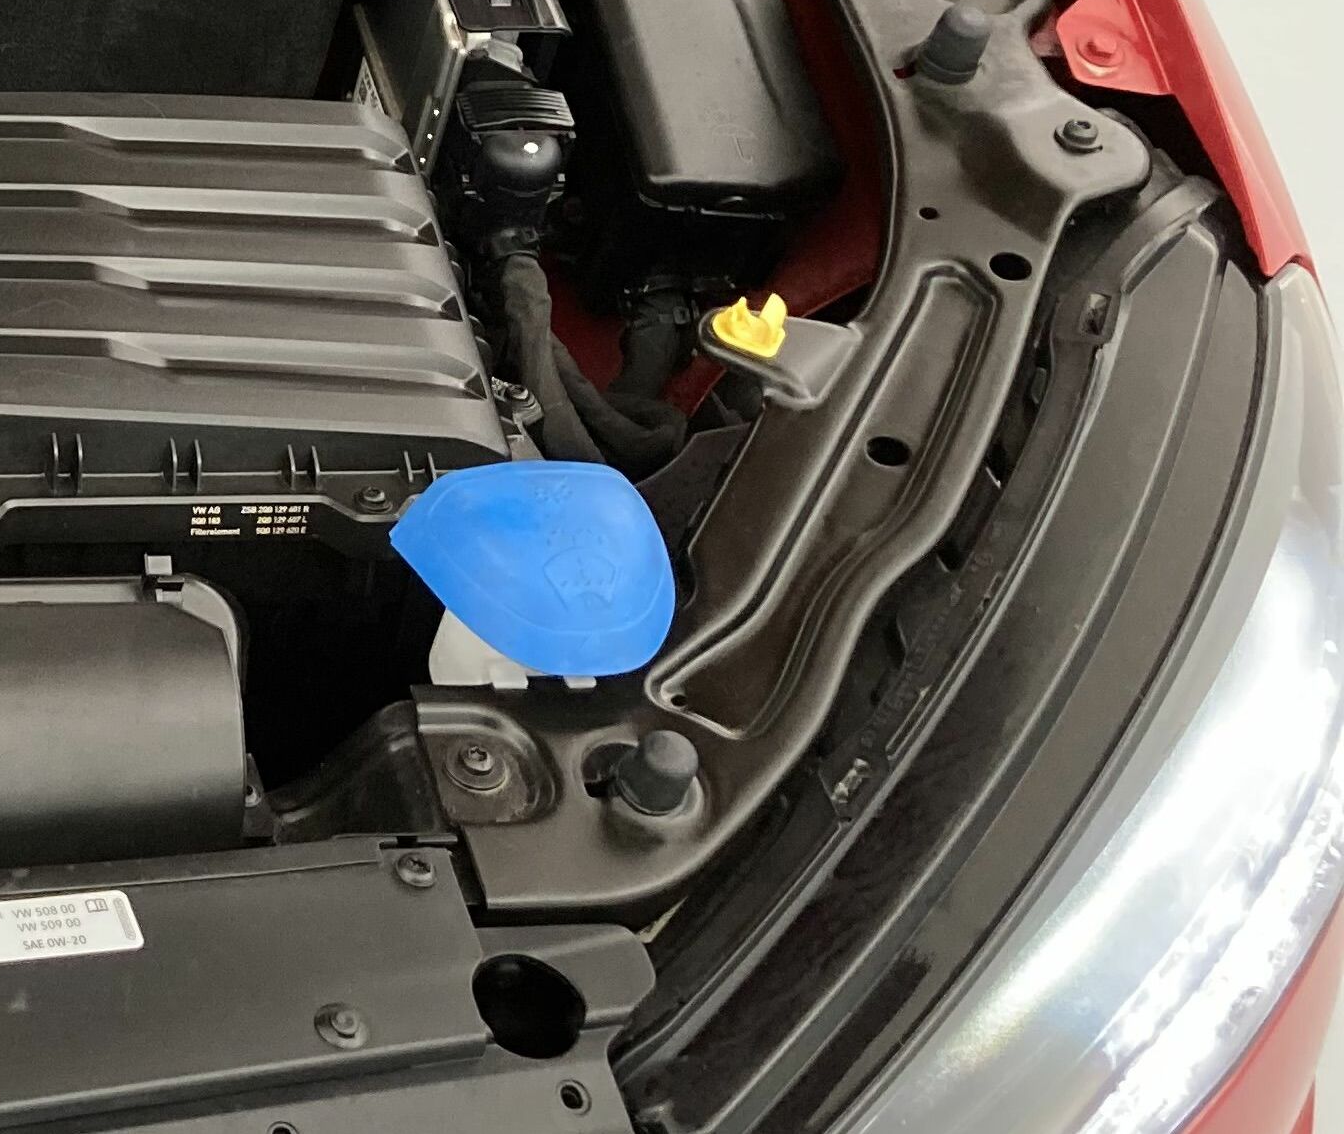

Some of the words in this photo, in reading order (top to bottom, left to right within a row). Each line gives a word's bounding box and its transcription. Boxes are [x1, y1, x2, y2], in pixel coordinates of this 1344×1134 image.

[192, 506, 207, 515] VW
[207, 506, 221, 515] AG
[12, 907, 32, 919] VW
[35, 905, 58, 917] 508
[61, 903, 76, 915] 00
[17, 921, 37, 933] VW
[40, 919, 63, 931] 509
[65, 917, 82, 928] 00
[23, 937, 45, 950] SAE
[48, 934, 87, 948] 0W-20
